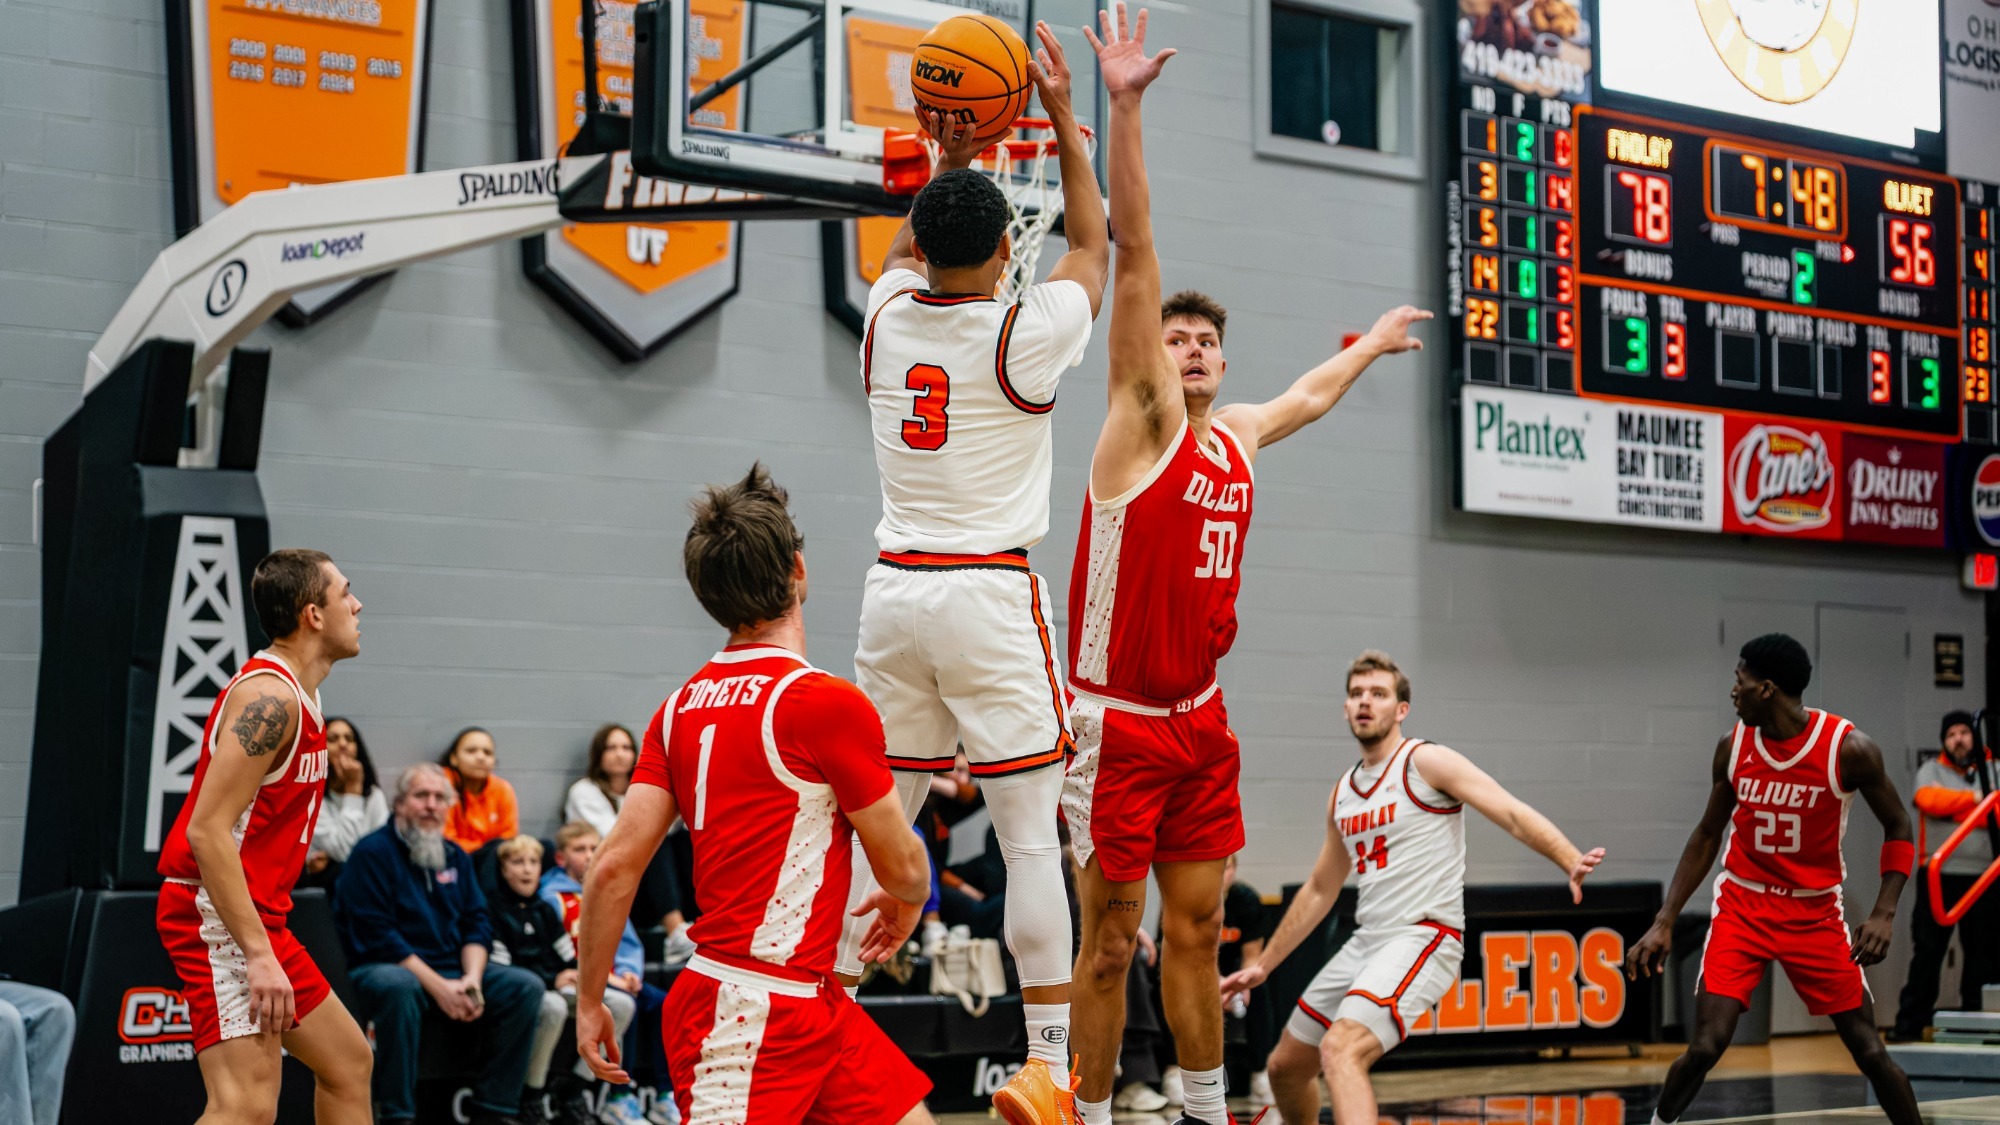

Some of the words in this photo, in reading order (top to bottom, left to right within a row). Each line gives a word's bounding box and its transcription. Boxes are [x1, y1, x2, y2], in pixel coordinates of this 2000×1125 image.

[1967, 14, 2000, 41] OH
[1943, 40, 2000, 74] LOGIS
[683, 139, 730, 160] SPALDING
[1486, 118, 1497, 154] 1
[1517, 122, 1535, 162] 2
[1554, 129, 1572, 168] 0
[458, 161, 559, 205] SPALDING
[1479, 161, 1498, 201] 3
[1525, 170, 1535, 207] 1
[1547, 173, 1573, 212] 14
[1740, 153, 1837, 231] 7:48
[1617, 170, 1671, 244] 78
[1980, 208, 1988, 240] 1
[626, 226, 669, 266] UF
[1480, 207, 1498, 248] 5
[1526, 215, 1536, 252] 1
[1556, 219, 1573, 259] 2
[1473, 253, 1499, 293] 14
[1889, 219, 1936, 287] 56
[1973, 248, 1988, 281] 4
[1519, 259, 1536, 299] 0
[1556, 265, 1574, 305] 3
[1794, 251, 1815, 304] 2
[1465, 297, 1499, 339] 22
[1969, 287, 1989, 321] 11
[1527, 307, 1538, 343] 1
[1556, 309, 1574, 350] 5
[1625, 316, 1648, 373] 3
[1969, 328, 1989, 362] 13
[1664, 322, 1686, 378] 3
[1869, 350, 1891, 404] 3
[1921, 358, 1940, 409] 3
[1965, 366, 1990, 403] 23
[901, 363, 951, 452] 3
[1474, 400, 1587, 462] Plantex
[1618, 411, 1704, 449] MAUMEE
[1618, 447, 1646, 477] BAY
[1653, 451, 1692, 481] TURF
[1735, 425, 1834, 517] Cane's
[1848, 457, 1939, 503] DRURY
[1195, 519, 1237, 579] 50
[294, 749, 328, 783] OLIV
[694, 723, 717, 831] 1
[1737, 777, 1827, 809] OLIVET
[300, 790, 317, 845] 1
[1754, 810, 1802, 854] 23
[1355, 834, 1390, 875] 14
[1409, 927, 1626, 1036] LERS
[119, 1042, 195, 1064] GRAPHICS
